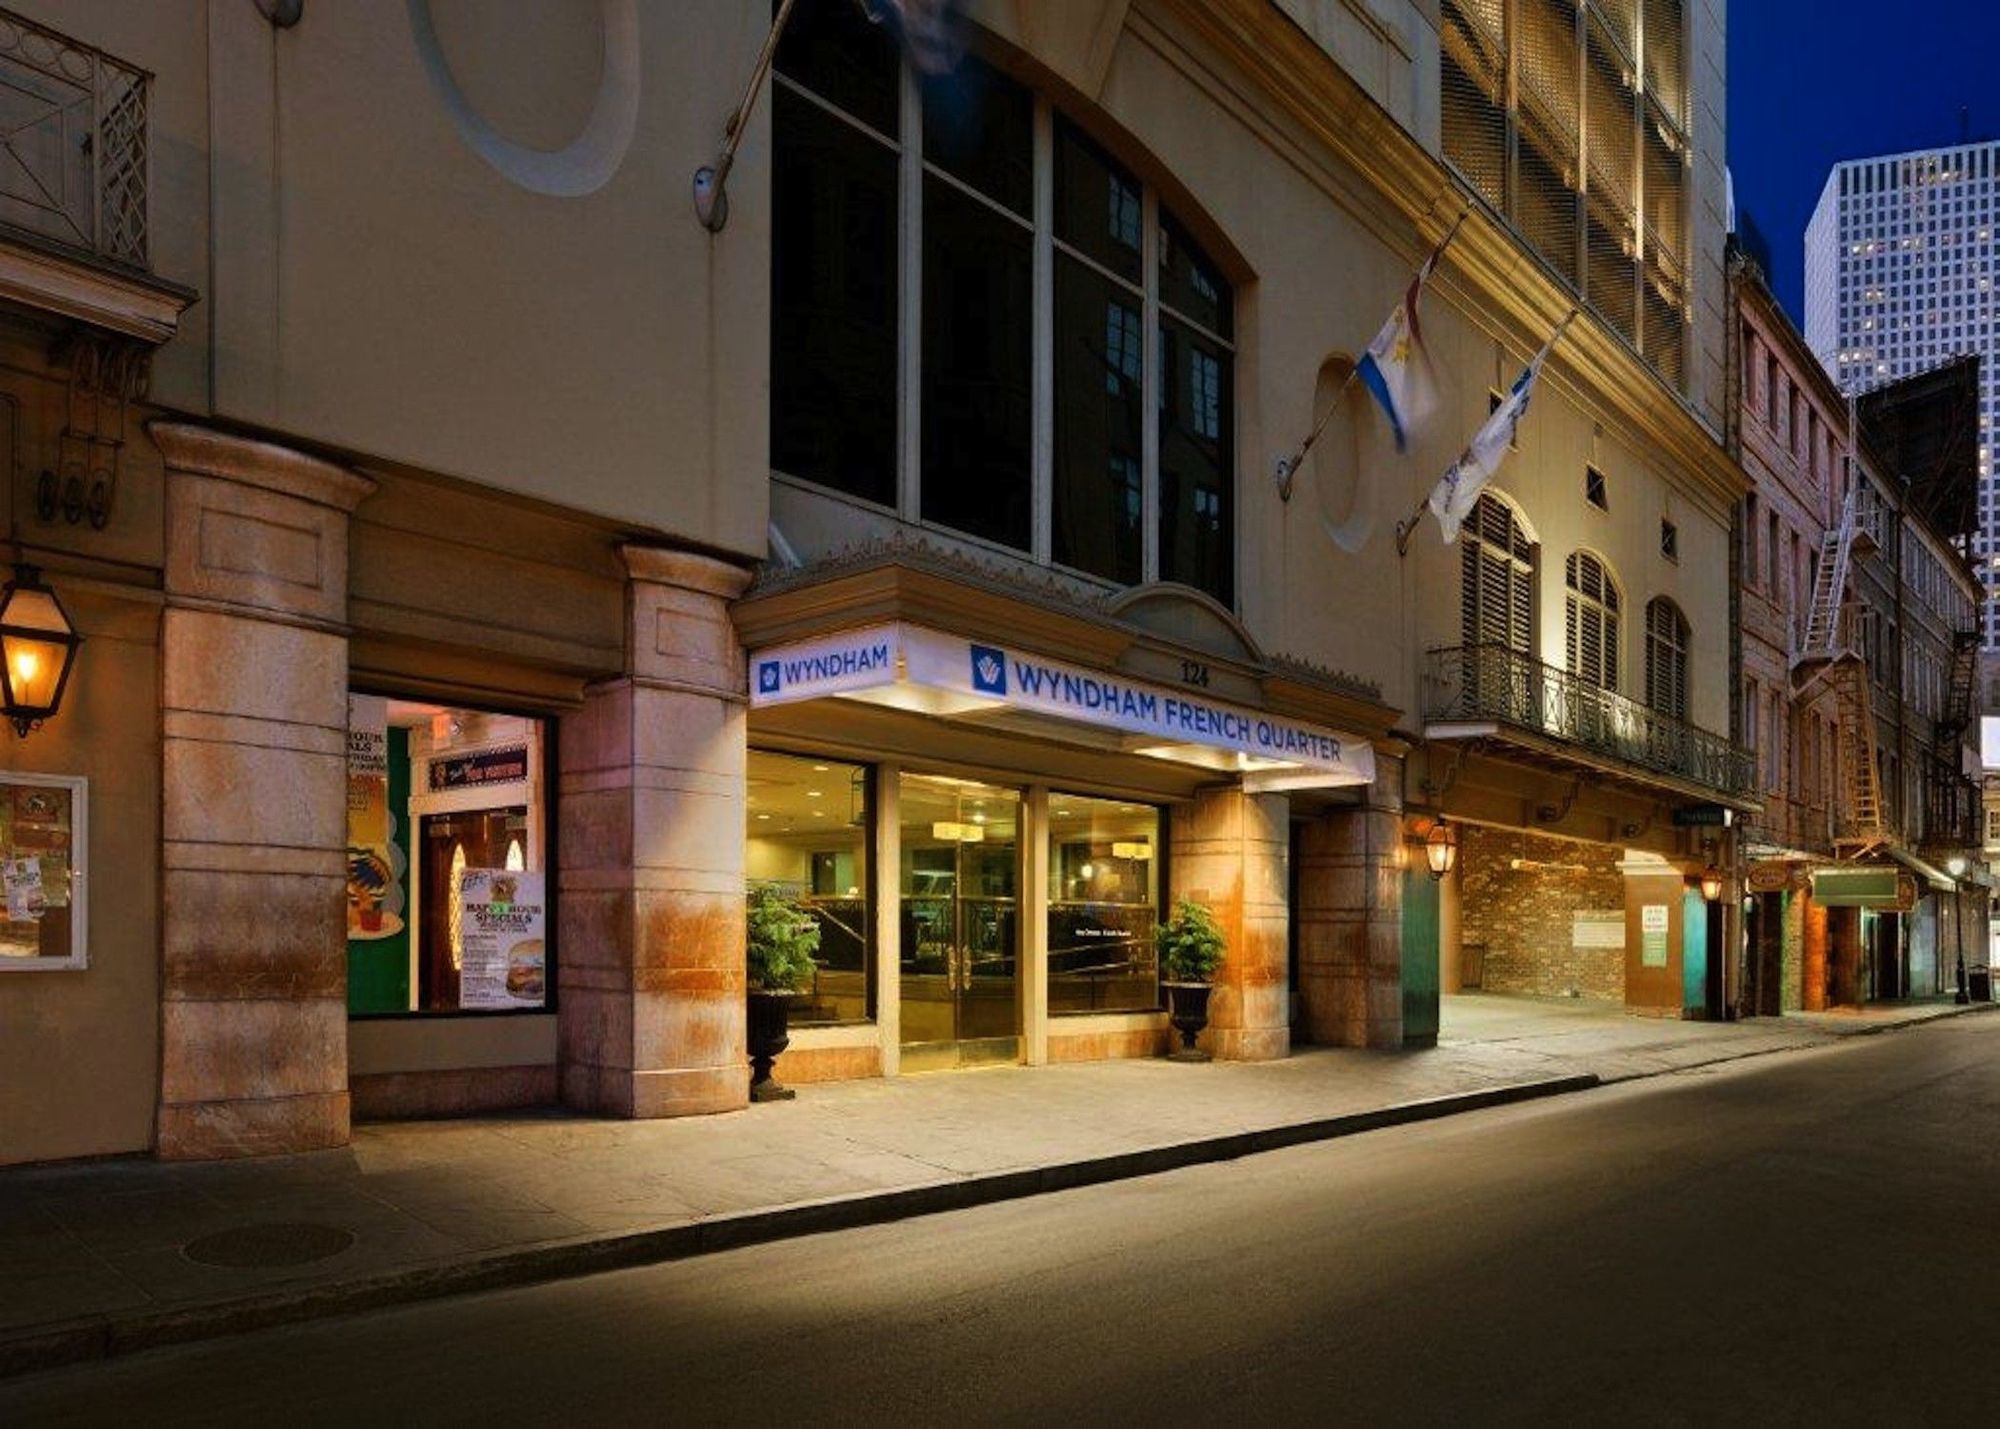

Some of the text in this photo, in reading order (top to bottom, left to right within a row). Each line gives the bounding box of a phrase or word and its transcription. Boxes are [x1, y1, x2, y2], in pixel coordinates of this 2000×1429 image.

[783, 645, 888, 685] WYNDHAM
[1181, 660, 1209, 689] 124
[1015, 661, 1342, 762] WYNDHAM FRENCH QUARTER
